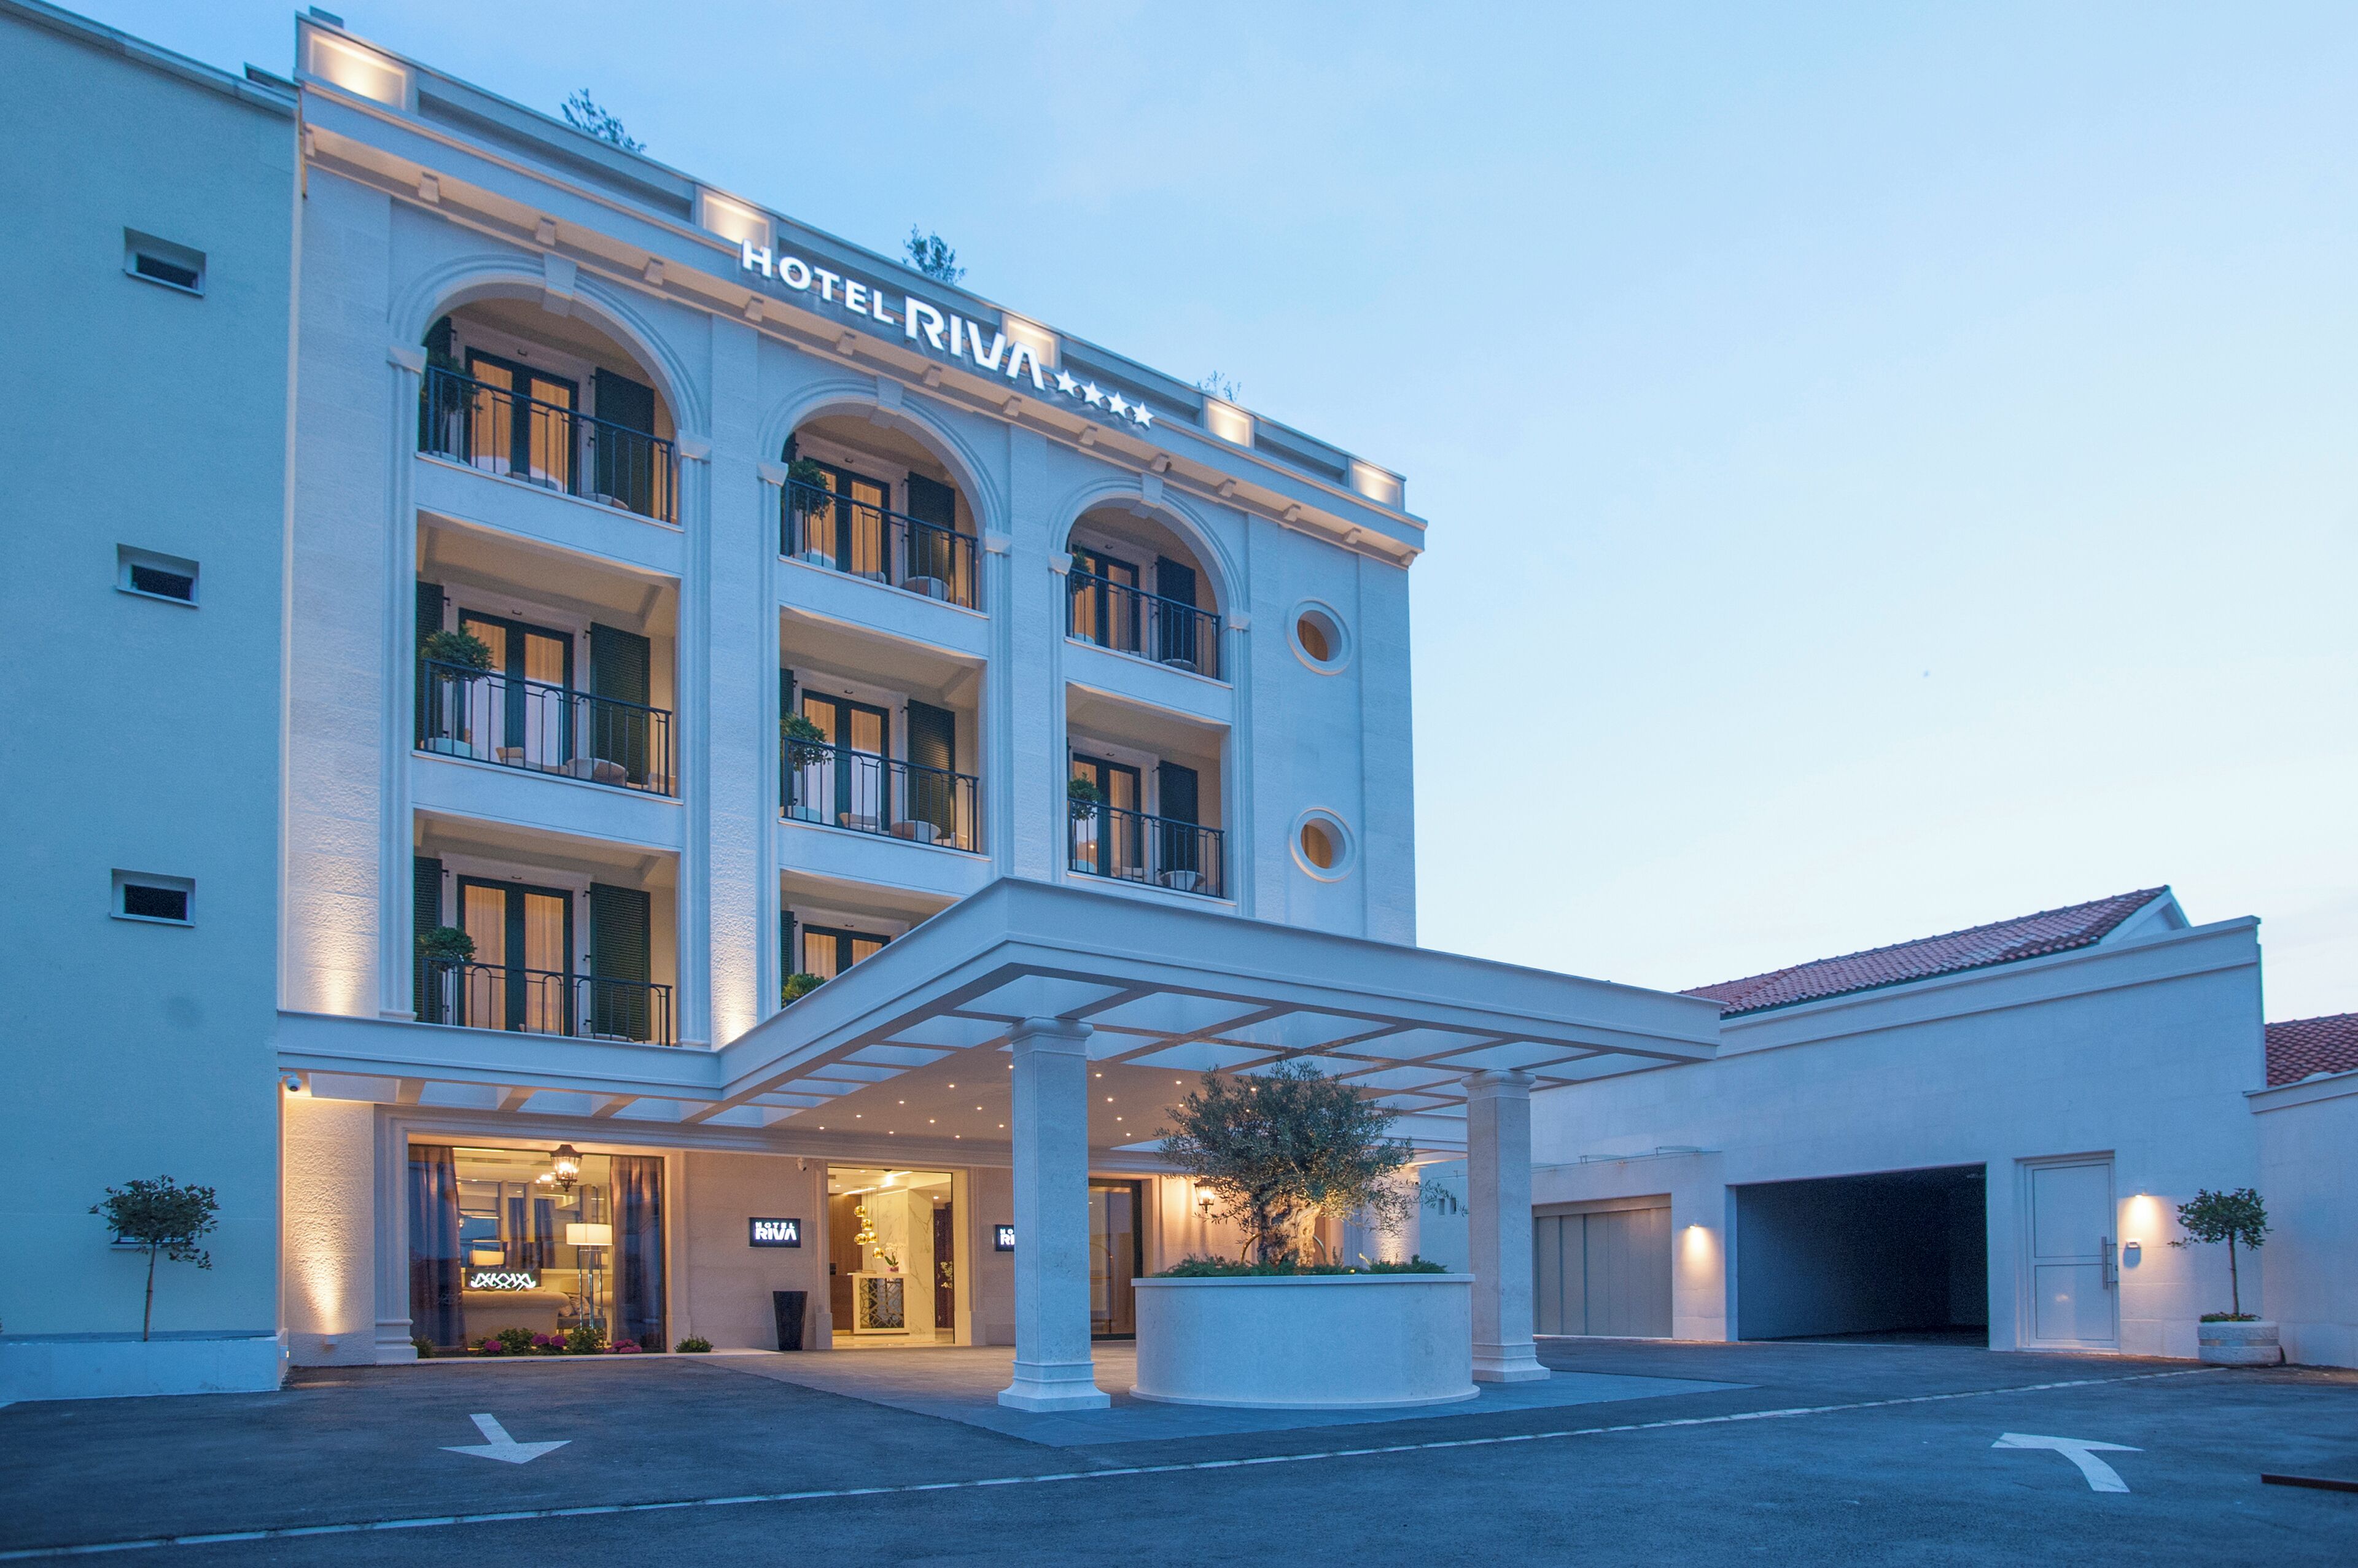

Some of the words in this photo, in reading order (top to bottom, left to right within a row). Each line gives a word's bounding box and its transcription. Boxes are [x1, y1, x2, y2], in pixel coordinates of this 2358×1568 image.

[742, 238, 895, 325] HOTEL
[905, 295, 1046, 390] RIVA
[755, 1228, 797, 1240] RIVA
[1000, 1234, 1015, 1245] RI
